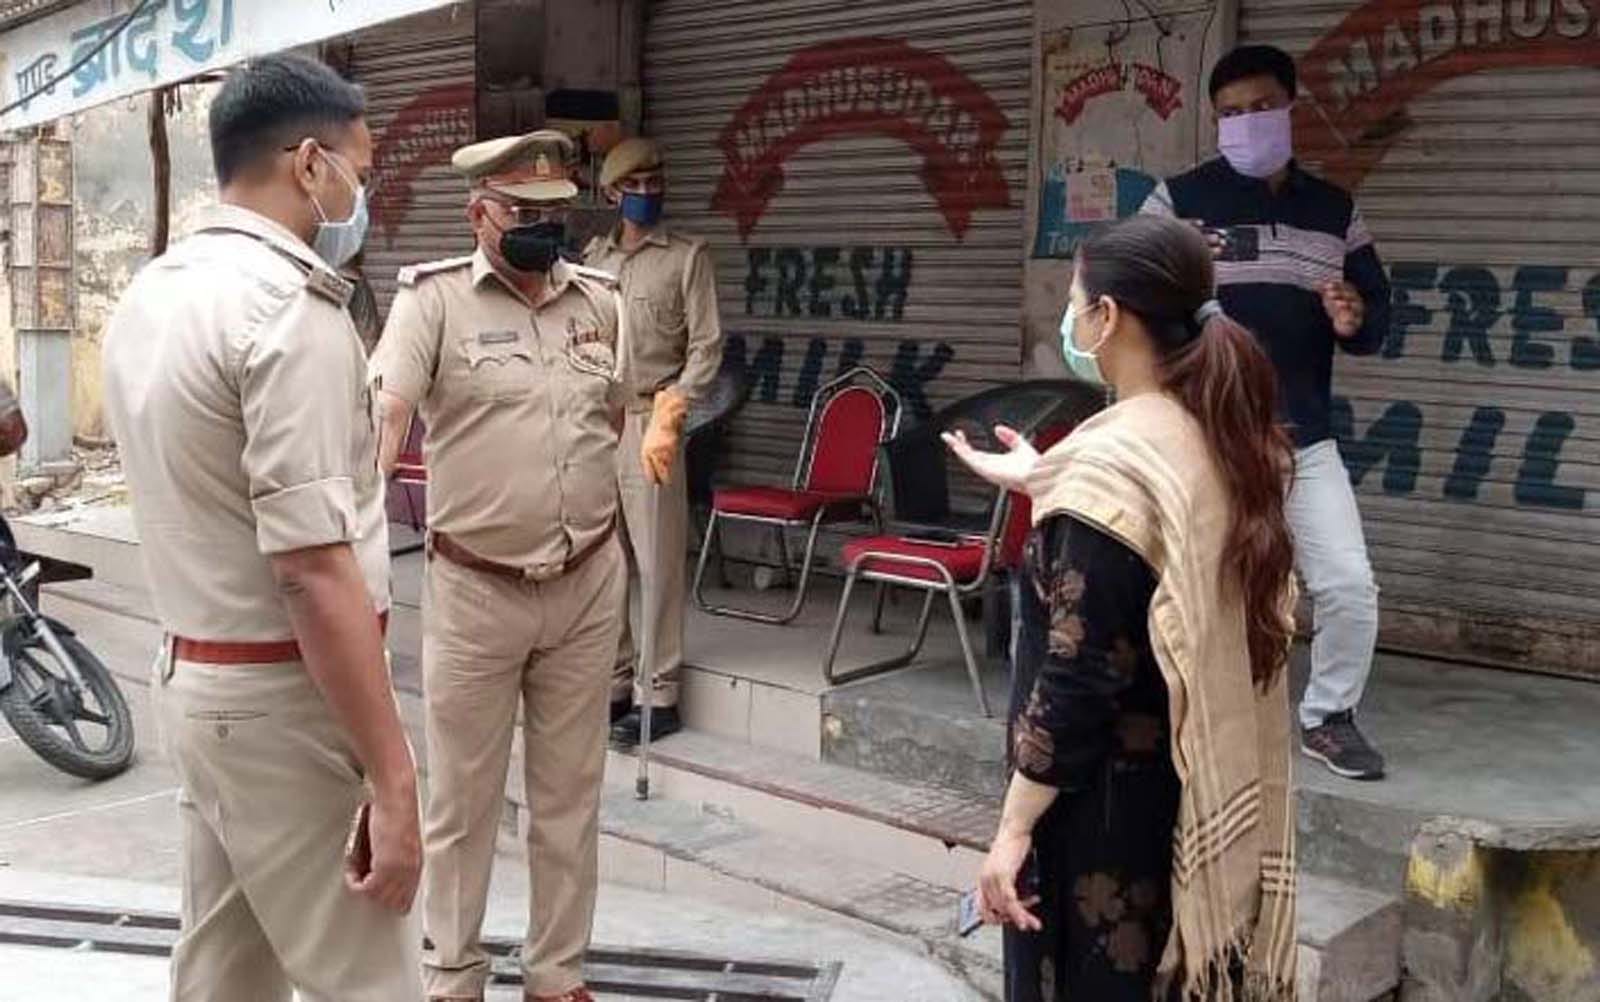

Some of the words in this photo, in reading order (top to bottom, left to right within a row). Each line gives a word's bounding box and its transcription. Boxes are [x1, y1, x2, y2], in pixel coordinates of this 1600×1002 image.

[1326, 0, 1600, 110] MADHUS
[746, 247, 912, 320] FRESH
[1330, 396, 1586, 509] MIL
